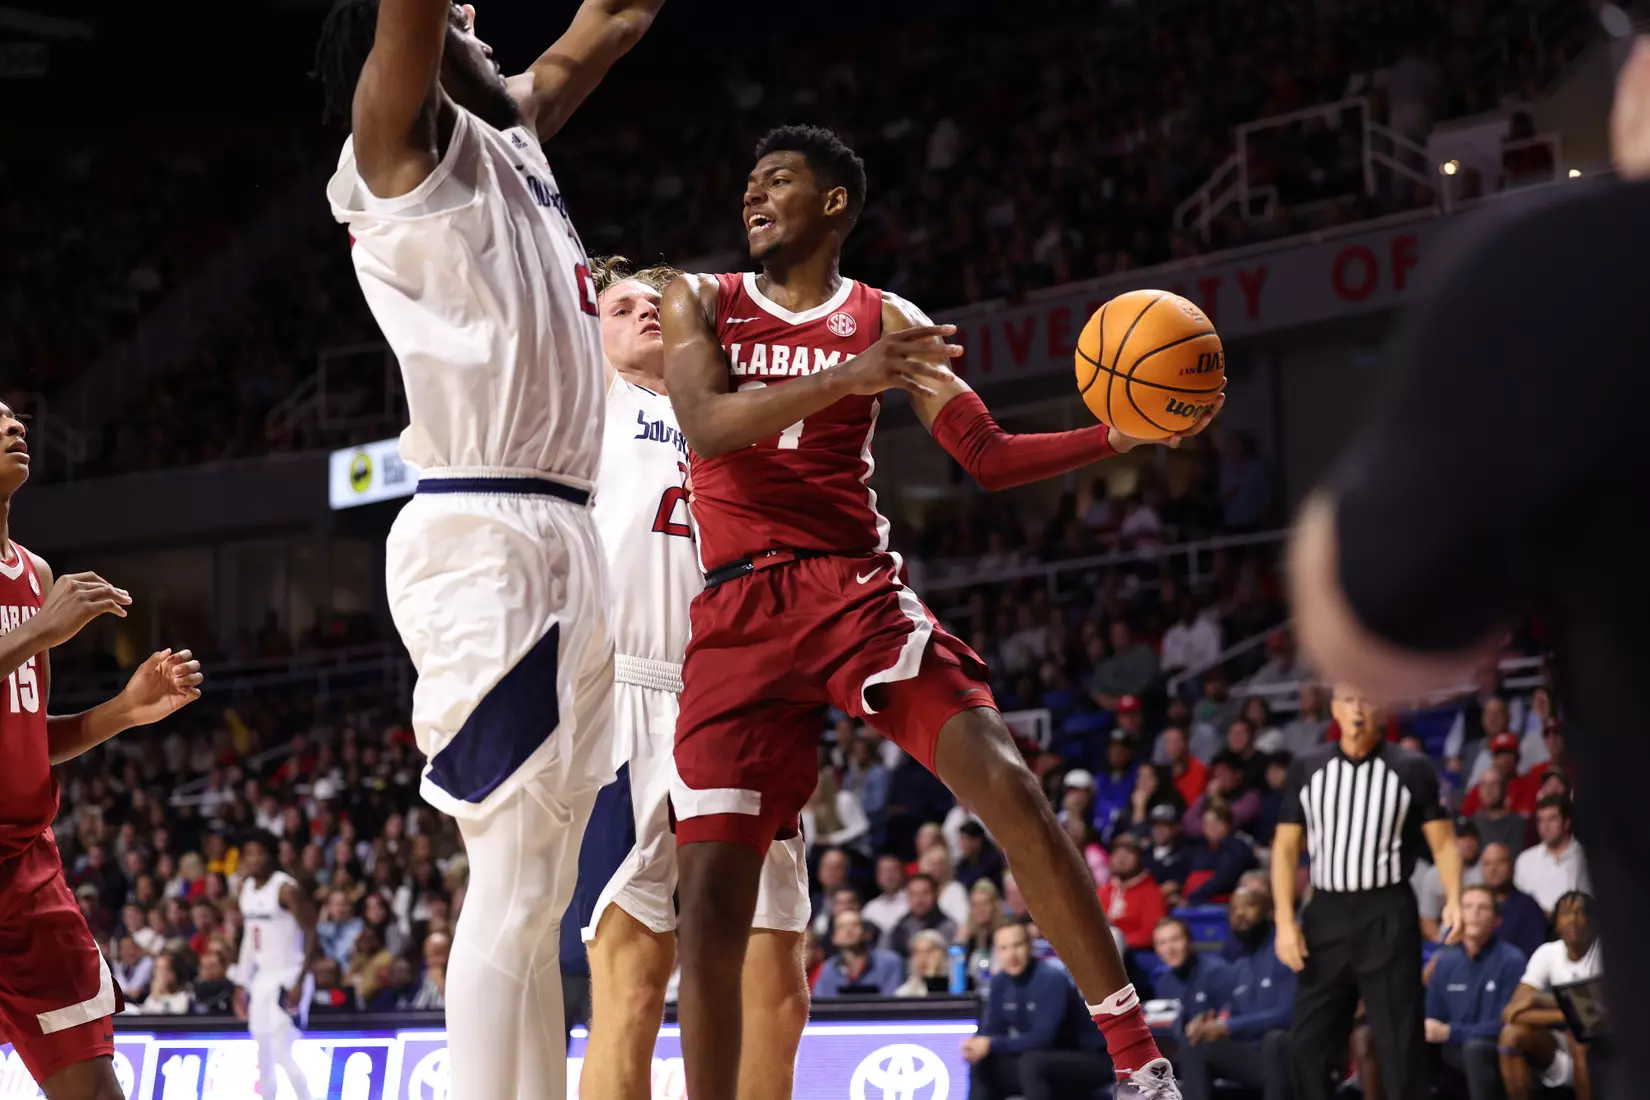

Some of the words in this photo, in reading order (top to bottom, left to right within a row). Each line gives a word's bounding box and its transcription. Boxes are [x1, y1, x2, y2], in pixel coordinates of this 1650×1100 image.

[1330, 235, 1420, 302] OF
[830, 315, 856, 336] SEC
[722, 343, 857, 376] LABAM
[8, 655, 39, 713] 15
